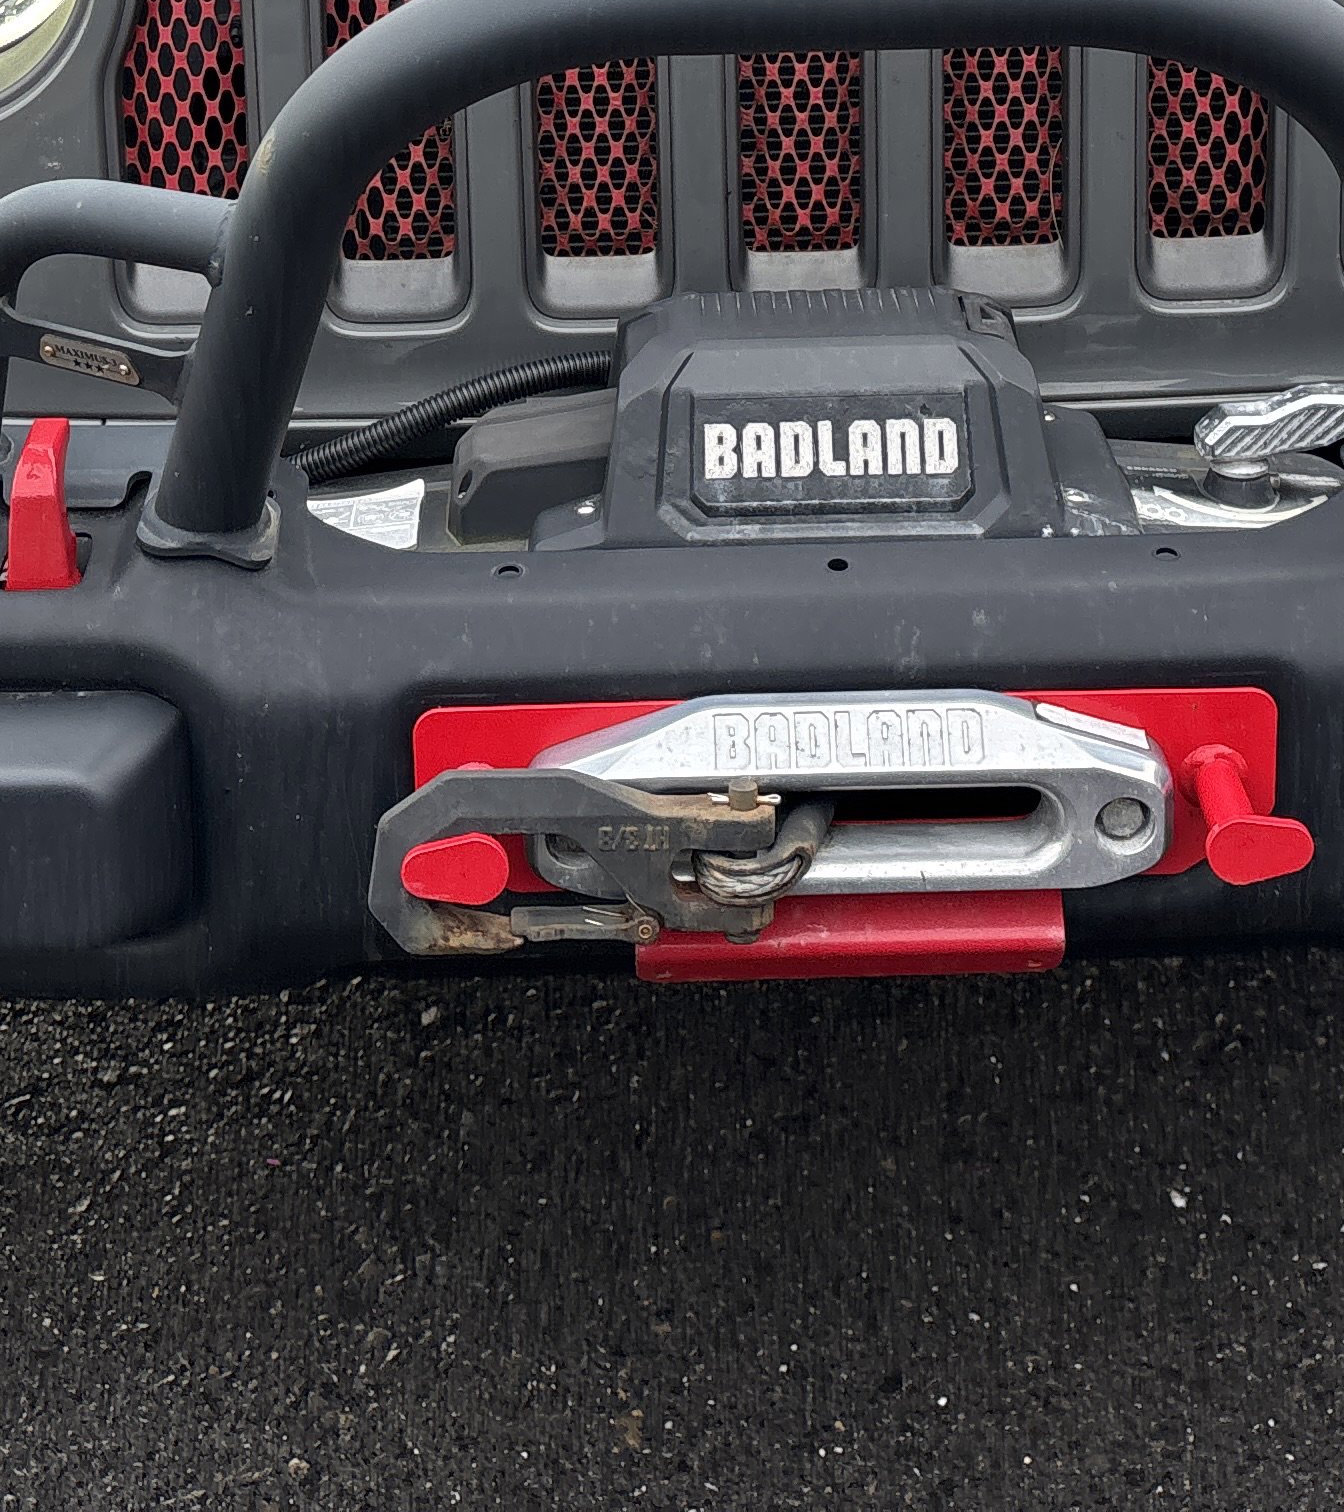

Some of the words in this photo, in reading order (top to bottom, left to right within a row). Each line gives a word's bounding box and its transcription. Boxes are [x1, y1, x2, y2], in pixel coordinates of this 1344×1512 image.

[55, 344, 117, 366] MAXIMUS-3
[704, 418, 958, 480] BADLAND
[712, 707, 986, 770] BADLAND
